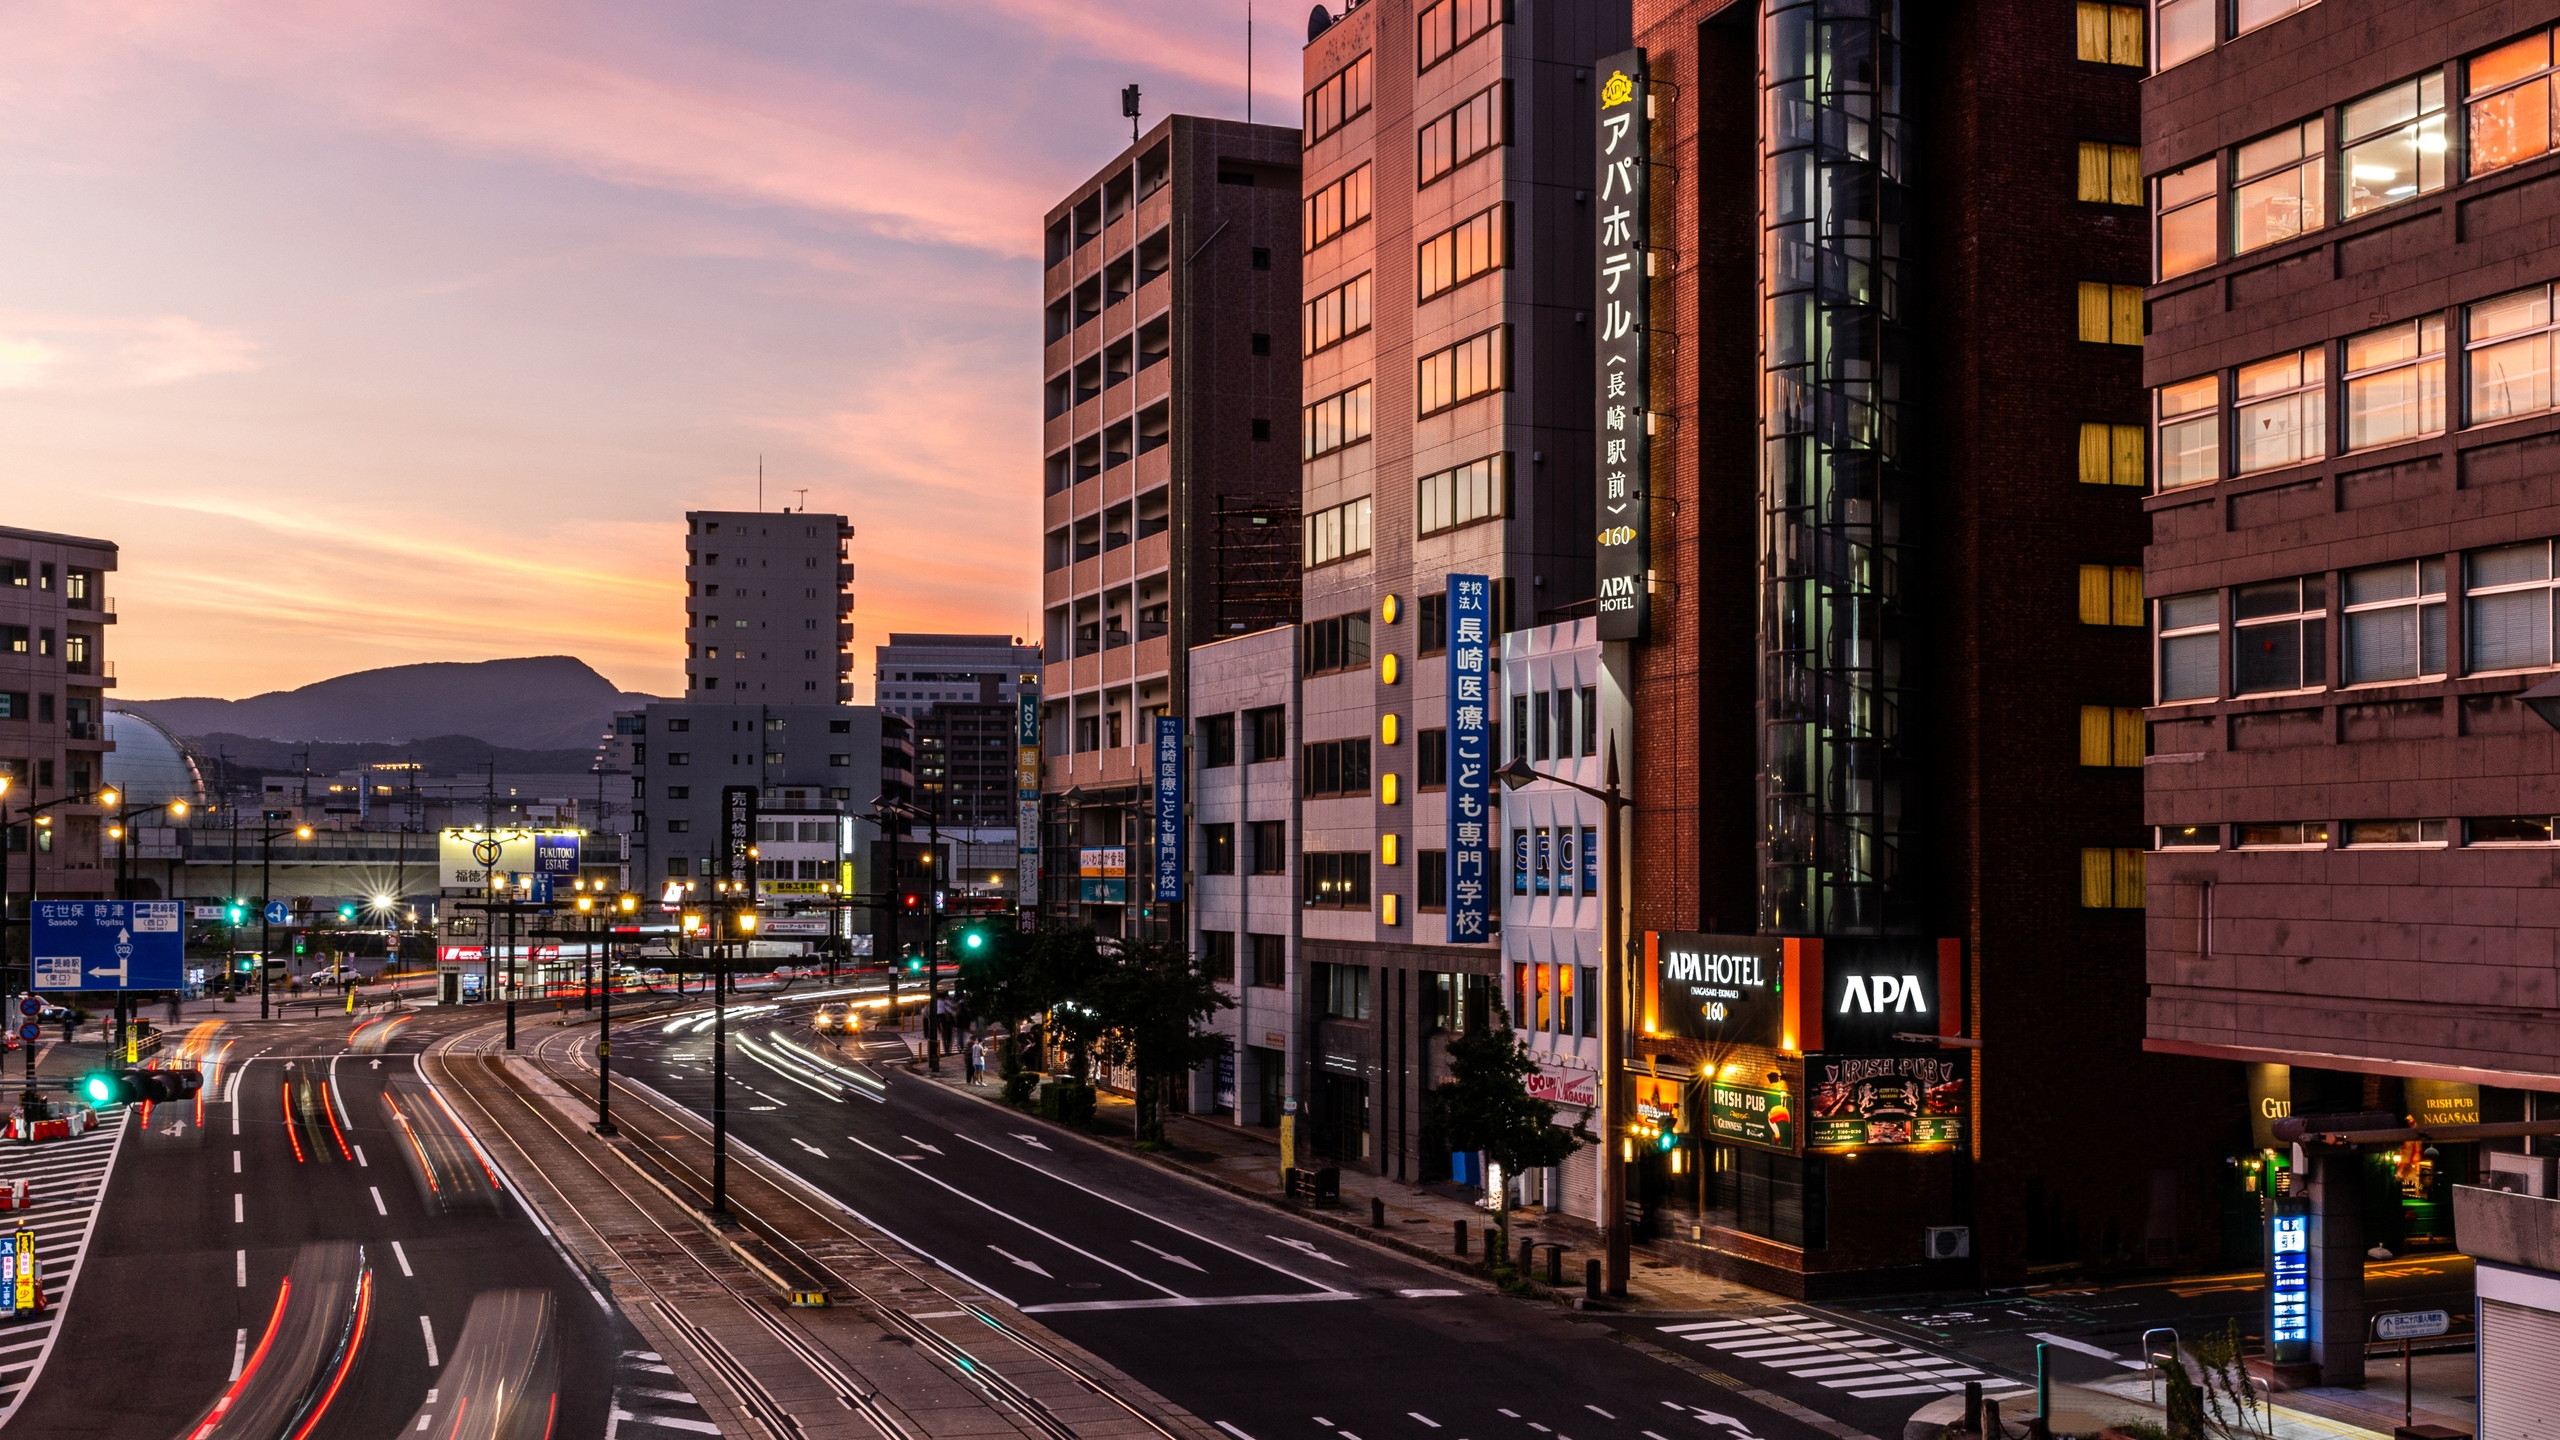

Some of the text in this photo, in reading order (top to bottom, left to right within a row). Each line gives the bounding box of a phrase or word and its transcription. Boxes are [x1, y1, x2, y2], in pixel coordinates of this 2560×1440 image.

[1602, 112, 1633, 342] アパホテル
[1604, 525, 1631, 547] 160
[1459, 581, 1482, 595] 学校
[1600, 575, 1634, 597] APA
[1459, 596, 1482, 611] 法人
[1600, 596, 1634, 612] HOTEL
[1024, 703, 1034, 737] NOVA
[1022, 751, 1036, 787] 歯科
[1456, 617, 1483, 935] 長崎医療こども専門学校
[1160, 735, 1177, 889] 長崎医療こども専門学校
[540, 847, 575, 858] FUKUTOKU
[545, 859, 570, 870] ESTATE
[41, 904, 85, 918] 佐世保
[94, 904, 125, 918] 時津
[151, 903, 177, 913] 長崎駅
[48, 918, 125, 928] Sasebo Togitsu
[54, 958, 80, 968] 長崎駅
[1667, 952, 1764, 986] APA HOTEL
[1840, 975, 1927, 1013] APA
[1705, 1002, 1724, 1021] 160
[1840, 1057, 1940, 1087] IRISH PUB
[1714, 1089, 1766, 1112] IRISH PUB
[2426, 1098, 2473, 1108] IRISH PUB
[1718, 1117, 1743, 1131] GUINNESS
[2423, 1112, 2480, 1124] NAGASAKI
